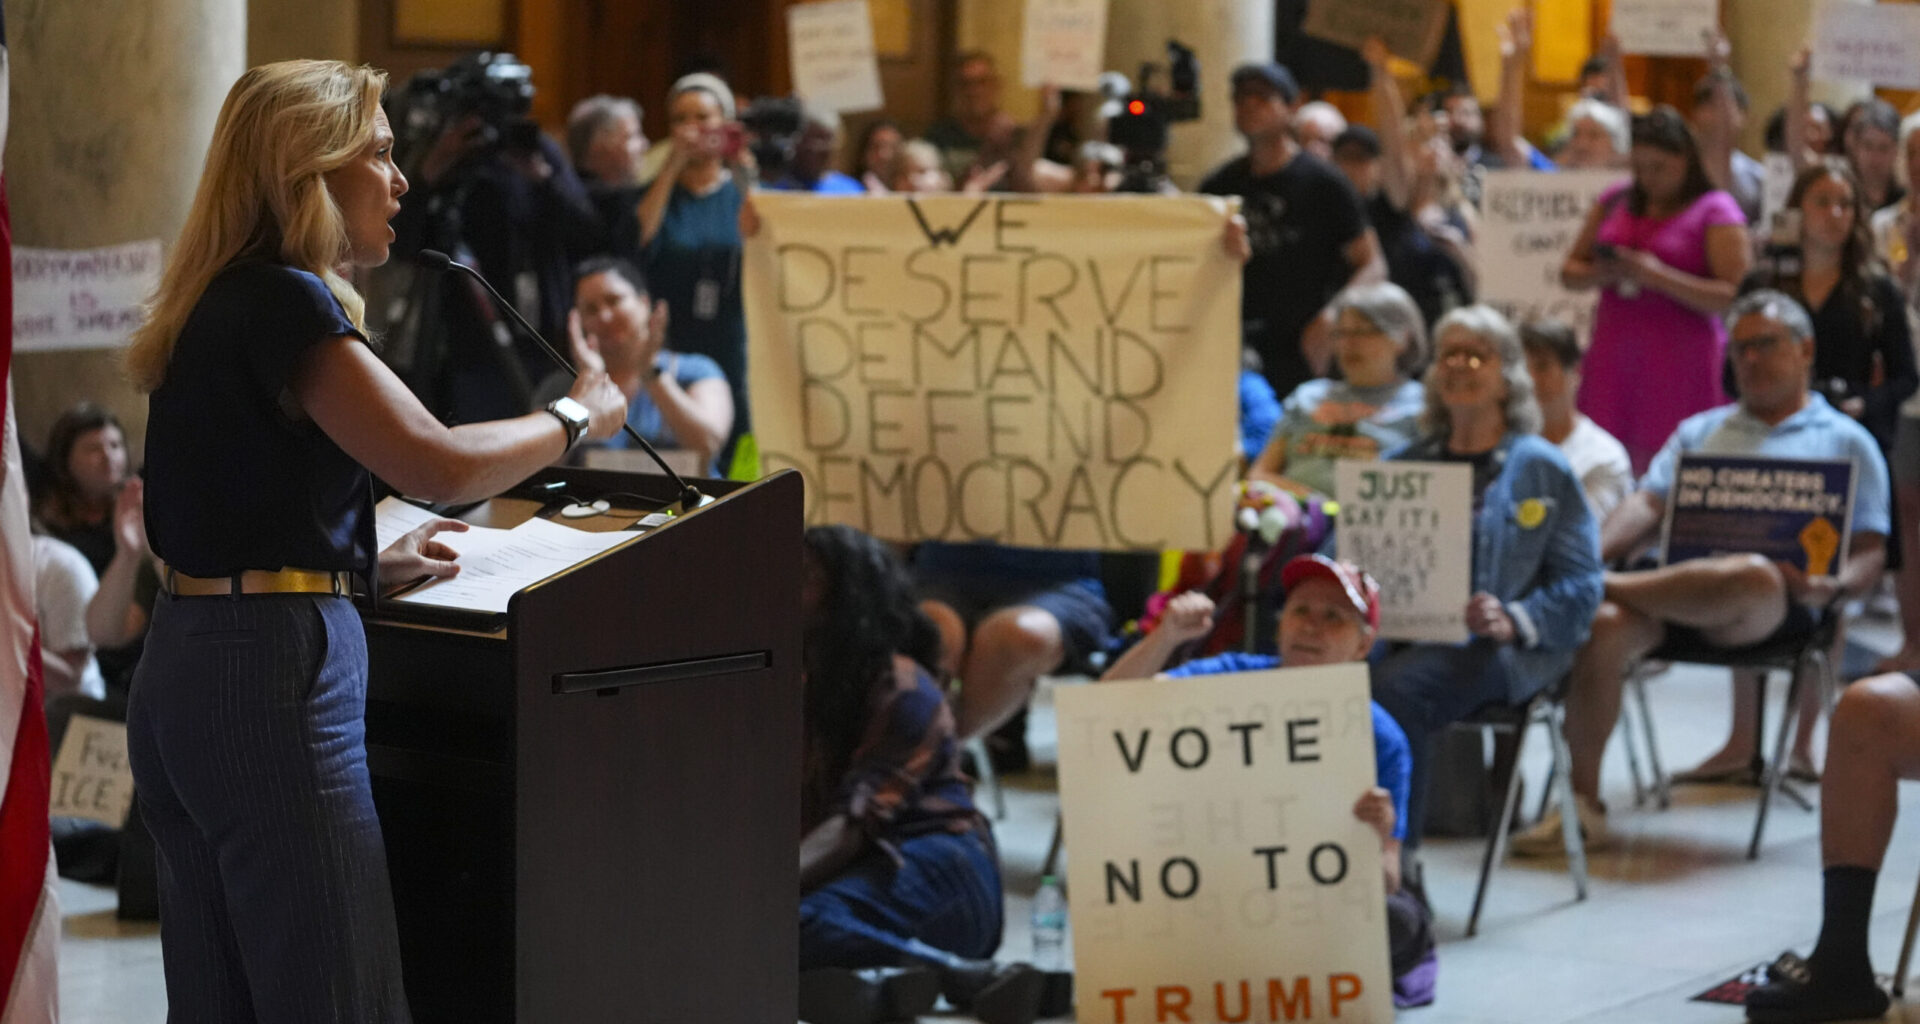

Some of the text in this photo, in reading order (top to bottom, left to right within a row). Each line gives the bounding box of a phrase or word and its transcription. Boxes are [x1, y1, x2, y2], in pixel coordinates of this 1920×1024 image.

[907, 199, 1040, 252] WE
[777, 243, 1196, 332] DESERVE
[801, 319, 1164, 400] DEMAND
[803, 378, 1153, 464] DEFEND
[1358, 470, 1432, 500] JUST
[79, 731, 130, 772] Fuc
[1114, 718, 1321, 773] VOTE
[52, 771, 112, 811] ICE
[1104, 842, 1349, 904] NO TO
[1101, 972, 1363, 1024] TRUMP
